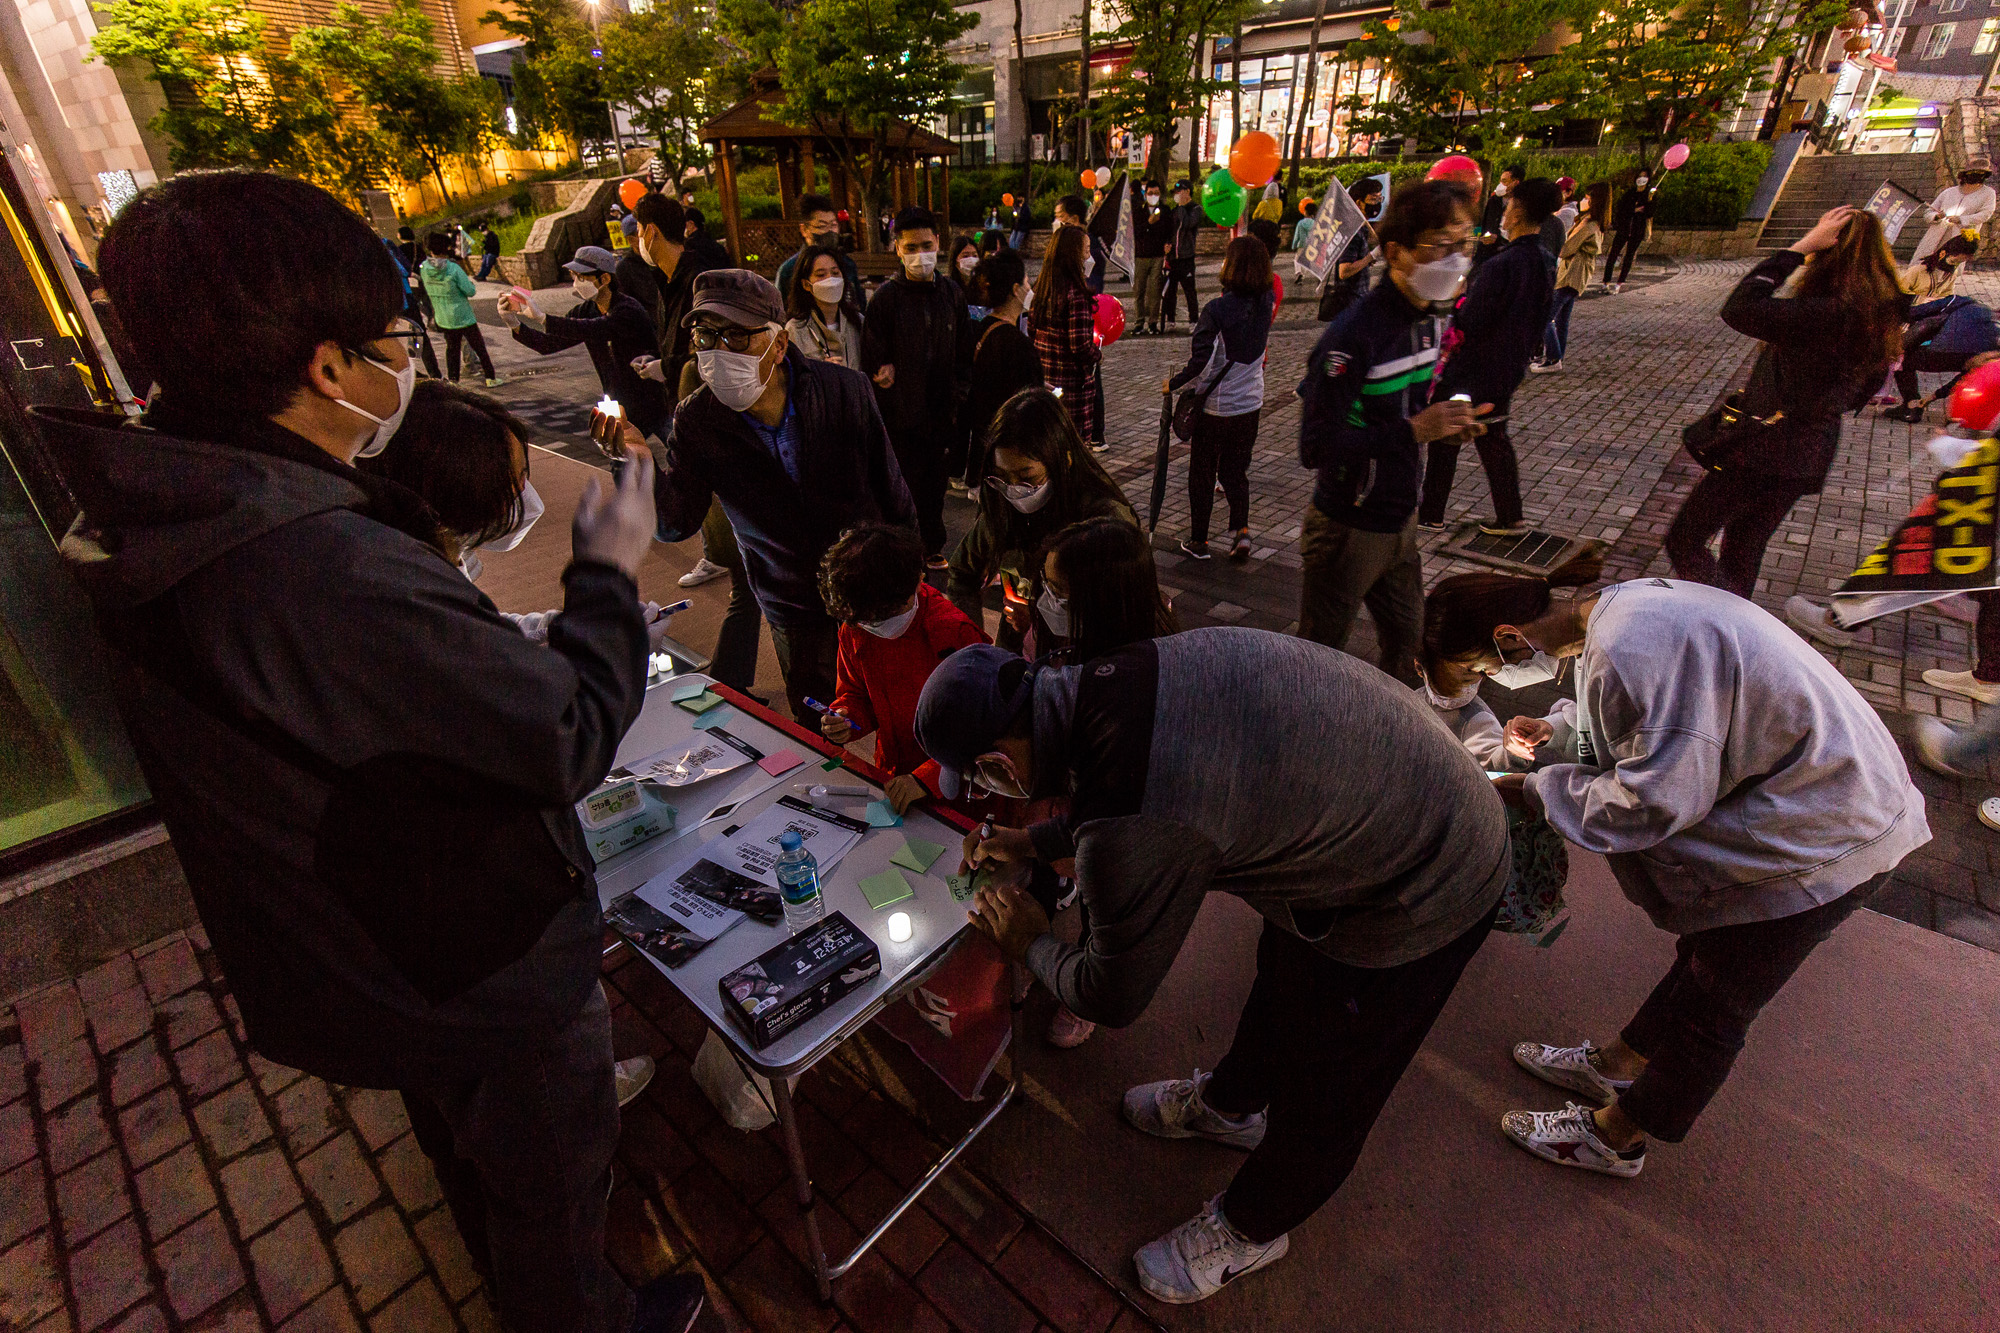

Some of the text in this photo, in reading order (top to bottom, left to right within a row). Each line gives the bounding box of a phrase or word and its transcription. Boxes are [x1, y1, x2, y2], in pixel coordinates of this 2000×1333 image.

[1933, 440, 2000, 575] TX-D
[766, 1011, 789, 1029] Chef's
[789, 997, 812, 1015] gloves
